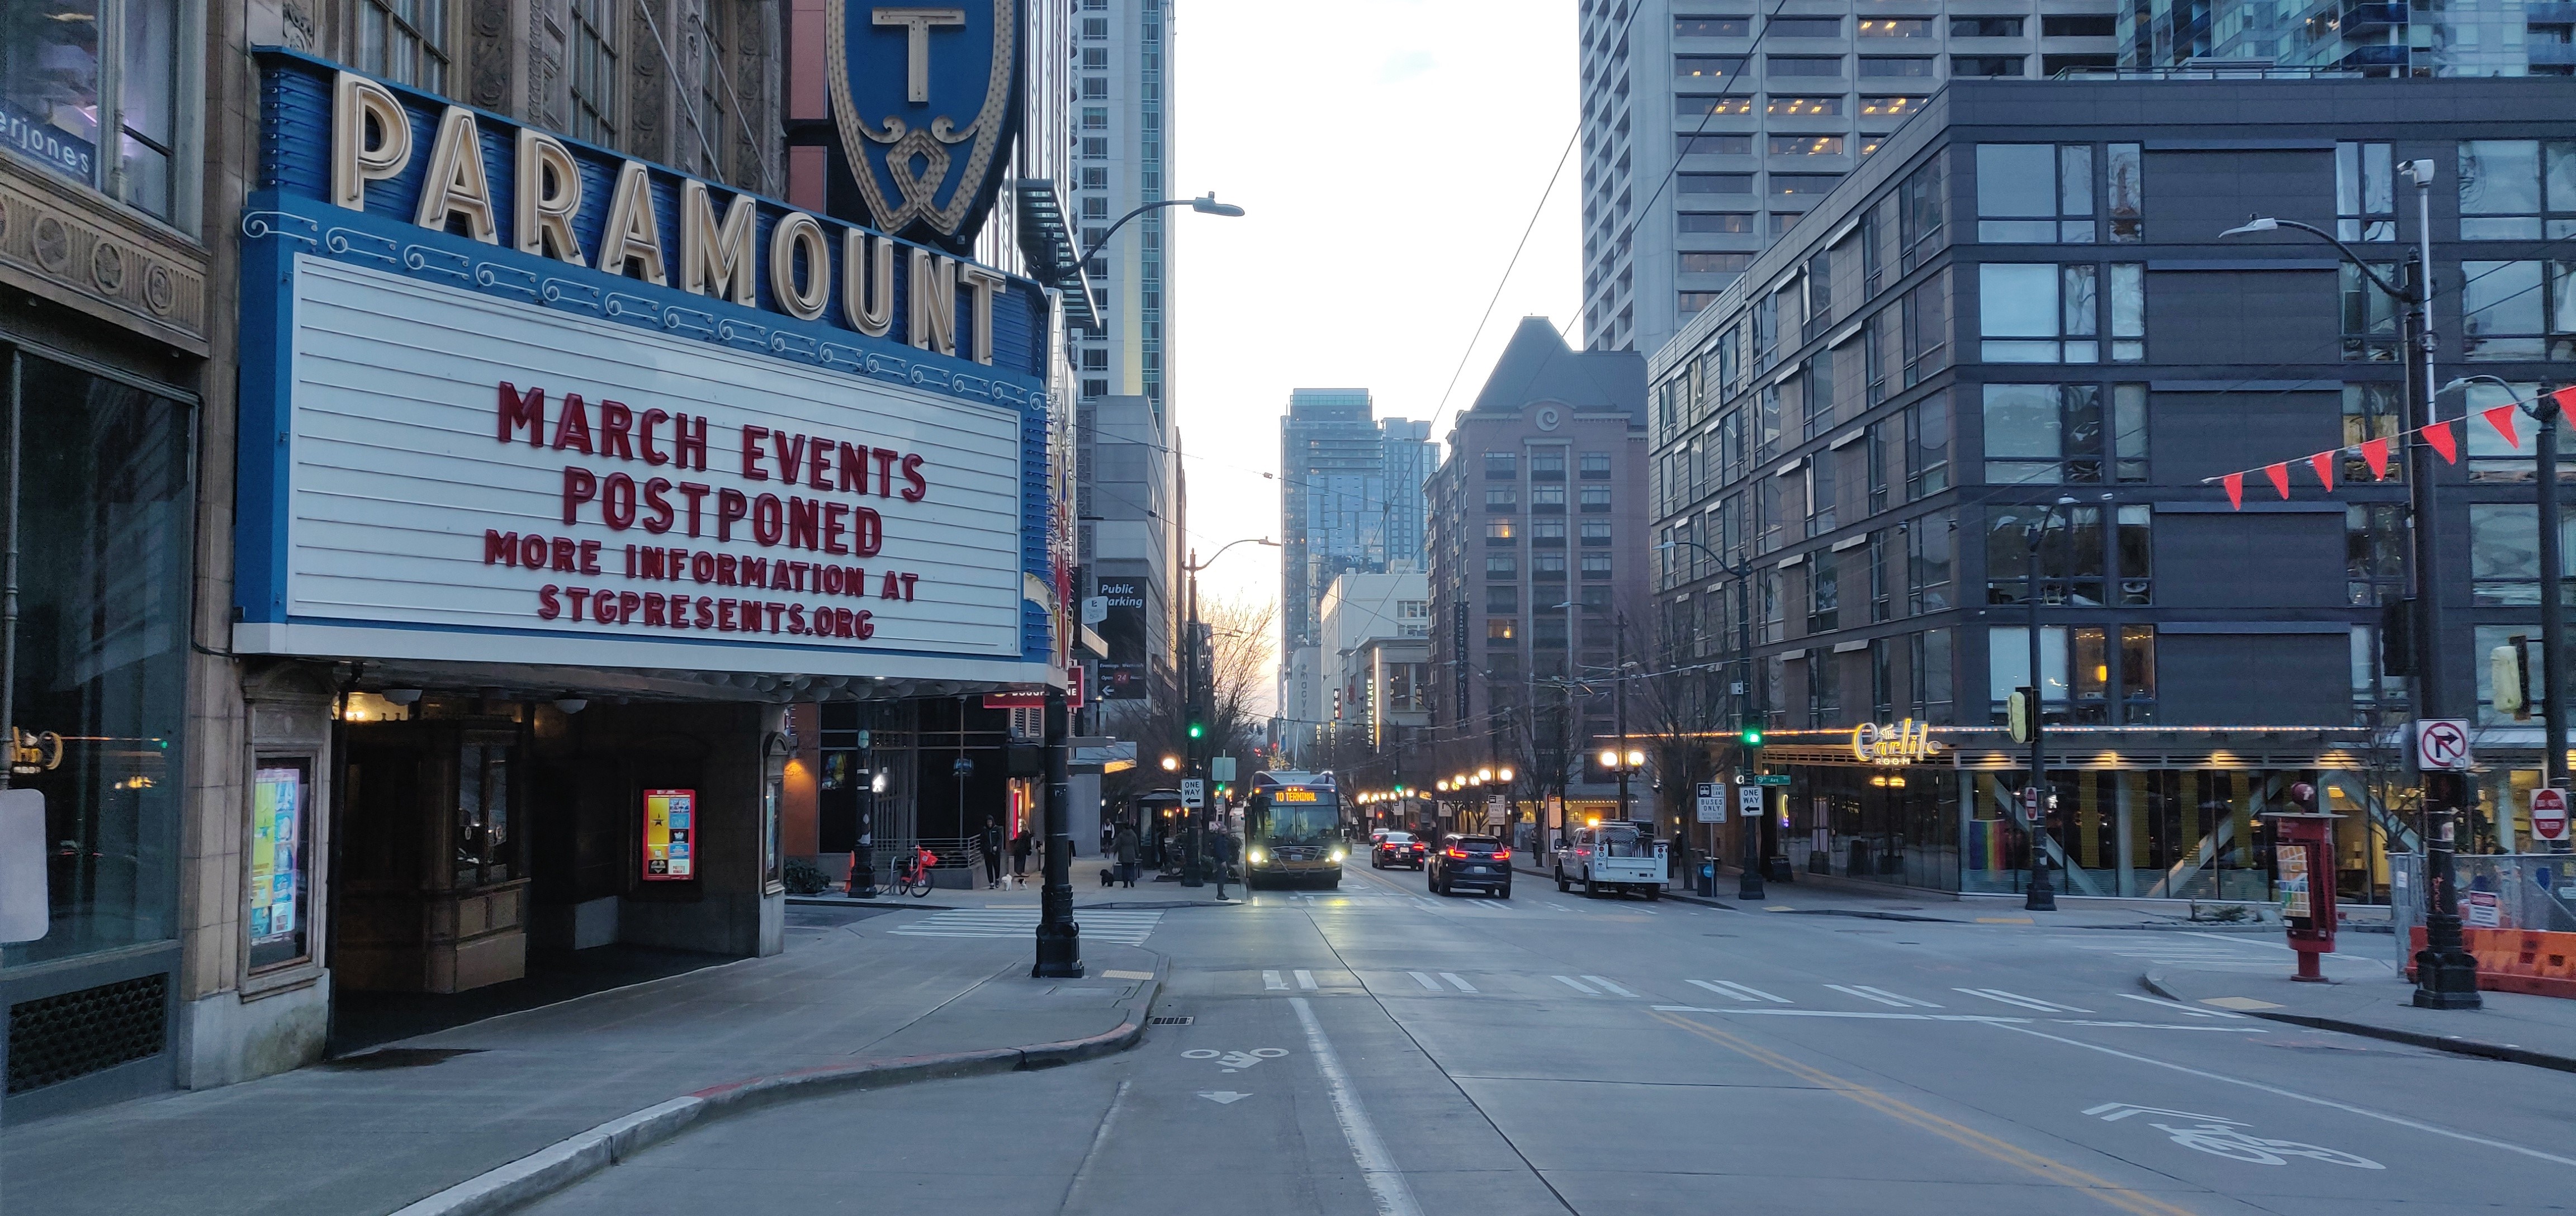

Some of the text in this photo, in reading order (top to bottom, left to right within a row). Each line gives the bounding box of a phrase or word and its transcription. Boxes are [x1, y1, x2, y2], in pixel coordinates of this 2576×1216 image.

[330, 70, 1008, 365] PARAMOUNT
[498, 380, 926, 502] MARCH EVENTS
[563, 466, 882, 558] POSTPONED
[484, 529, 919, 602] MORE INFORMATION AT
[1101, 583, 1134, 594] Public
[538, 583, 874, 640] STGPRESENTS.ORG
[1107, 596, 1143, 609] arking
[1880, 724, 1897, 740] THE
[1275, 792, 1317, 802] TO TERMINAL
